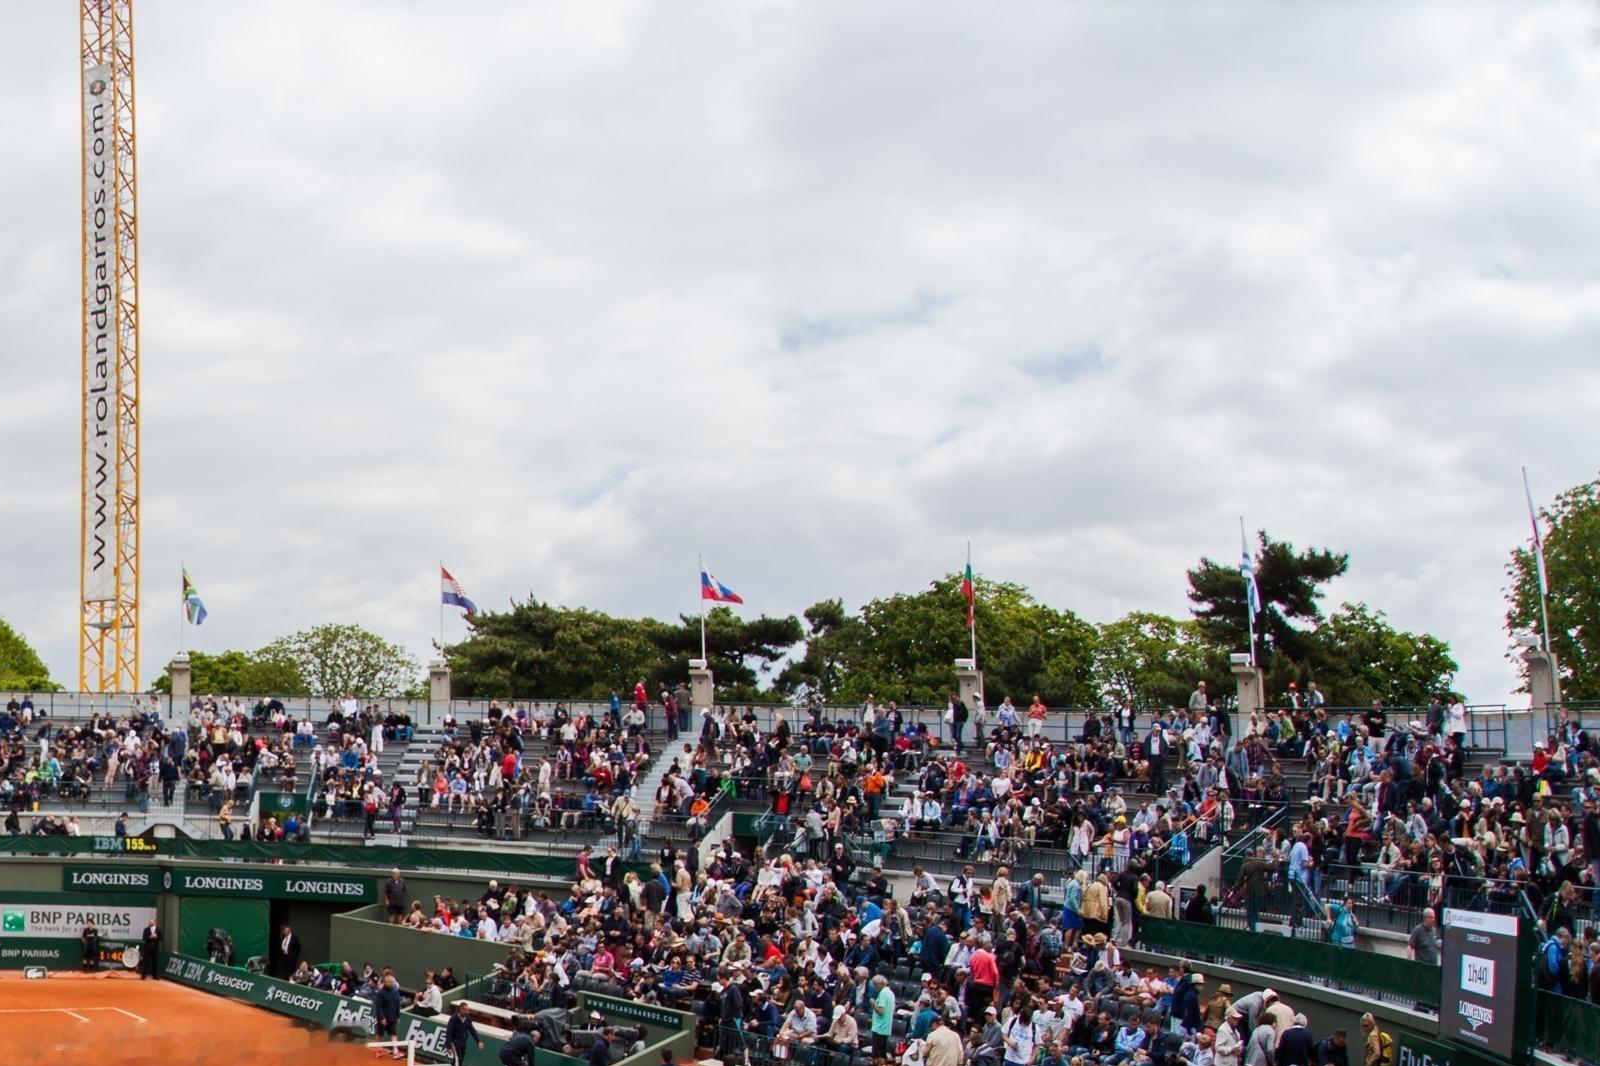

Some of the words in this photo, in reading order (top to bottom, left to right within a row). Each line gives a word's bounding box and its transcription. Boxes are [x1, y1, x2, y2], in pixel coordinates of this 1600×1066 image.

[90, 102, 111, 572] www.rolandgarros.com
[94, 837, 123, 850] IBM
[72, 872, 149, 886] LONGINES
[185, 876, 263, 891] LONGINES
[286, 880, 364, 896] LONGINES
[30, 911, 62, 925] BNP
[66, 911, 132, 926] PARIBAS
[1, 949, 20, 958] BNP
[21, 949, 59, 958] PARIBAS
[165, 956, 185, 975] IBM
[184, 960, 204, 981] IBM
[1467, 963, 1488, 985] 1h40
[213, 972, 254, 992] PEUGEOT
[274, 988, 323, 1012] PEUGEOT
[1458, 1000, 1493, 1024] LONGINES
